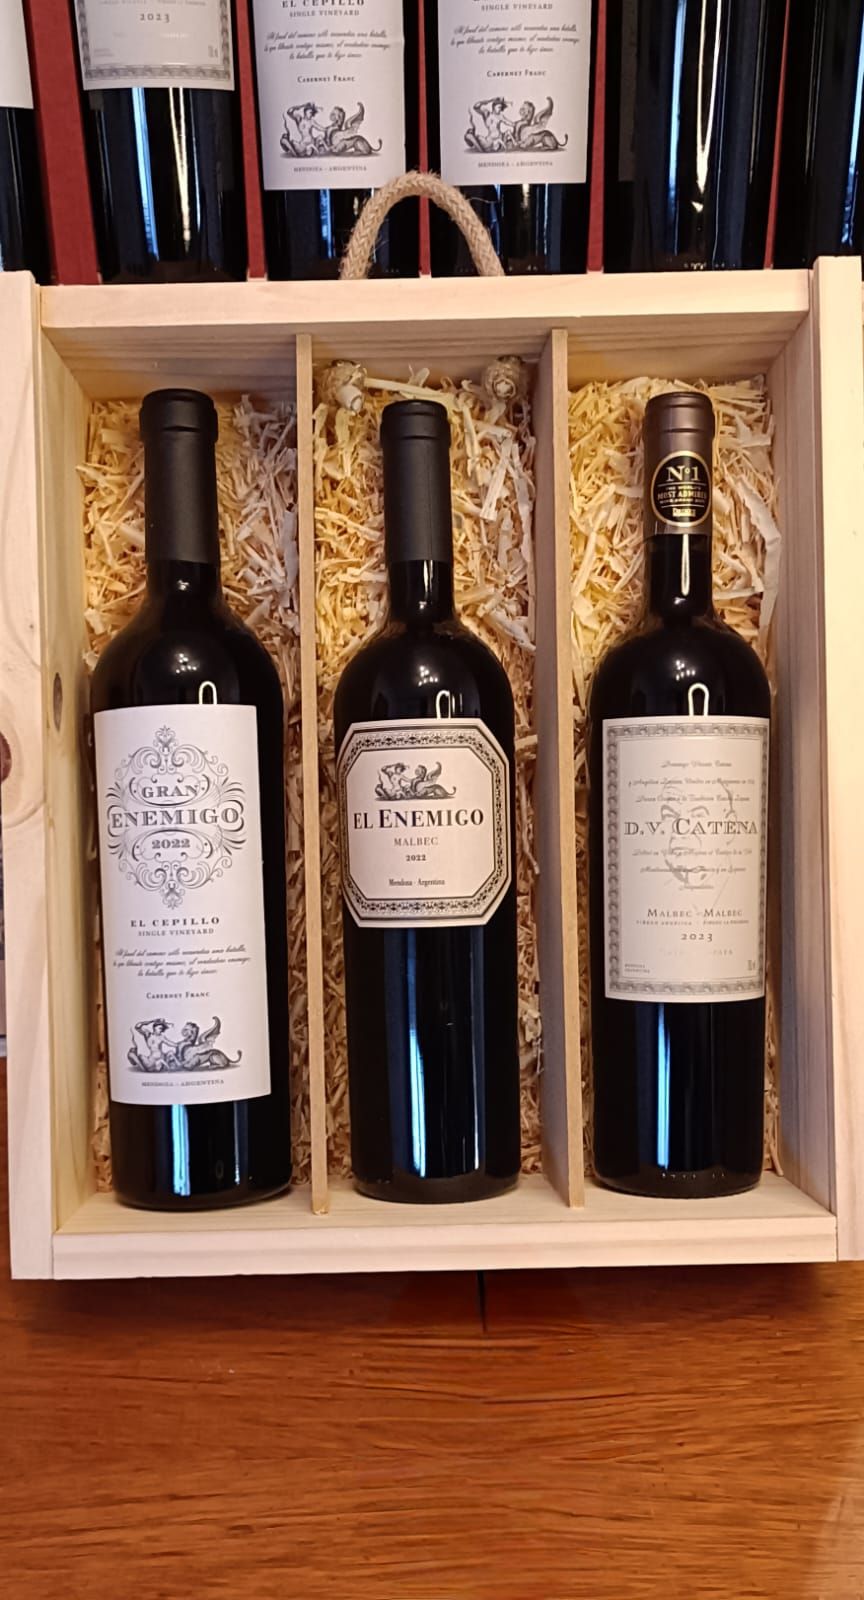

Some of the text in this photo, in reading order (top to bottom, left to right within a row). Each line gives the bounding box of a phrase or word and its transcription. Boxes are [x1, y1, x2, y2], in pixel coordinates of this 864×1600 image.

[140, 13, 170, 23] 2023
[142, 784, 198, 799] GRAN
[111, 808, 239, 828] ENEMIGO
[353, 808, 484, 829] EL ENEMIGO
[675, 818, 758, 836] CATENA
[152, 838, 190, 849] 2022
[394, 836, 439, 847] MALBEC
[406, 853, 426, 862] 2022
[417, 878, 445, 888] Argentina
[647, 908, 692, 918] MALBEC
[703, 908, 743, 917] MALBEC
[131, 917, 220, 928] EL CEPILLO
[170, 928, 214, 936] VINEYARD
[681, 933, 713, 942] 2023
[146, 992, 182, 1000] CABERNET
